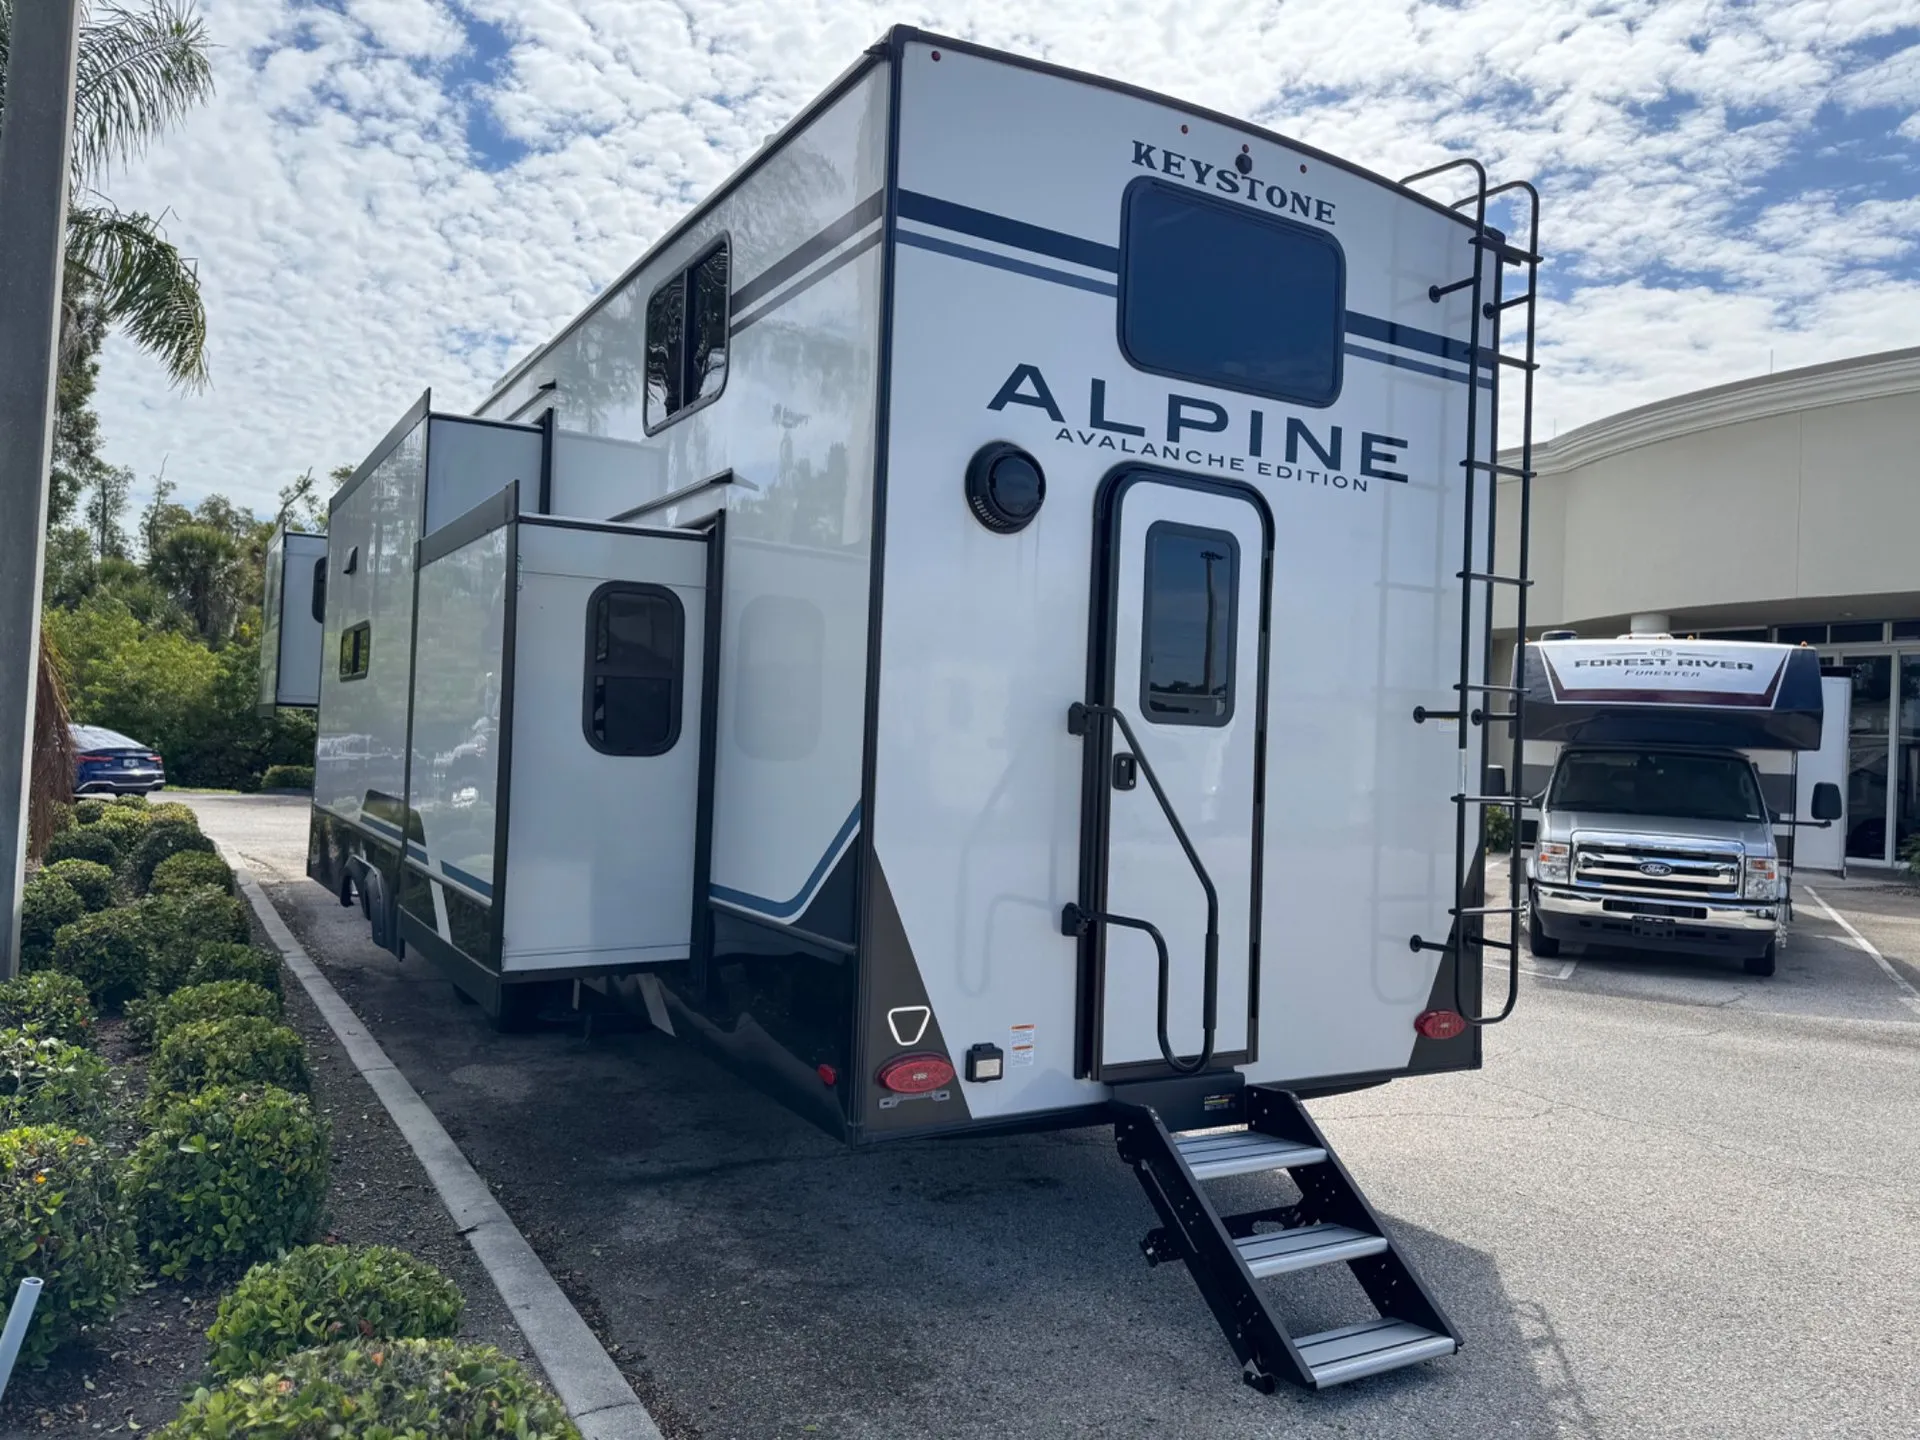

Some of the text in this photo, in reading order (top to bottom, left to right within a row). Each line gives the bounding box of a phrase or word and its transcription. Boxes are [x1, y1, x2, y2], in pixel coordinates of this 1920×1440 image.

[1131, 140, 1337, 226] KEYSTONE
[986, 362, 1409, 483] ALPINE
[1055, 427, 1368, 493] AVALANCHE EDITION
[1574, 658, 1754, 671] FOREST RIVER
